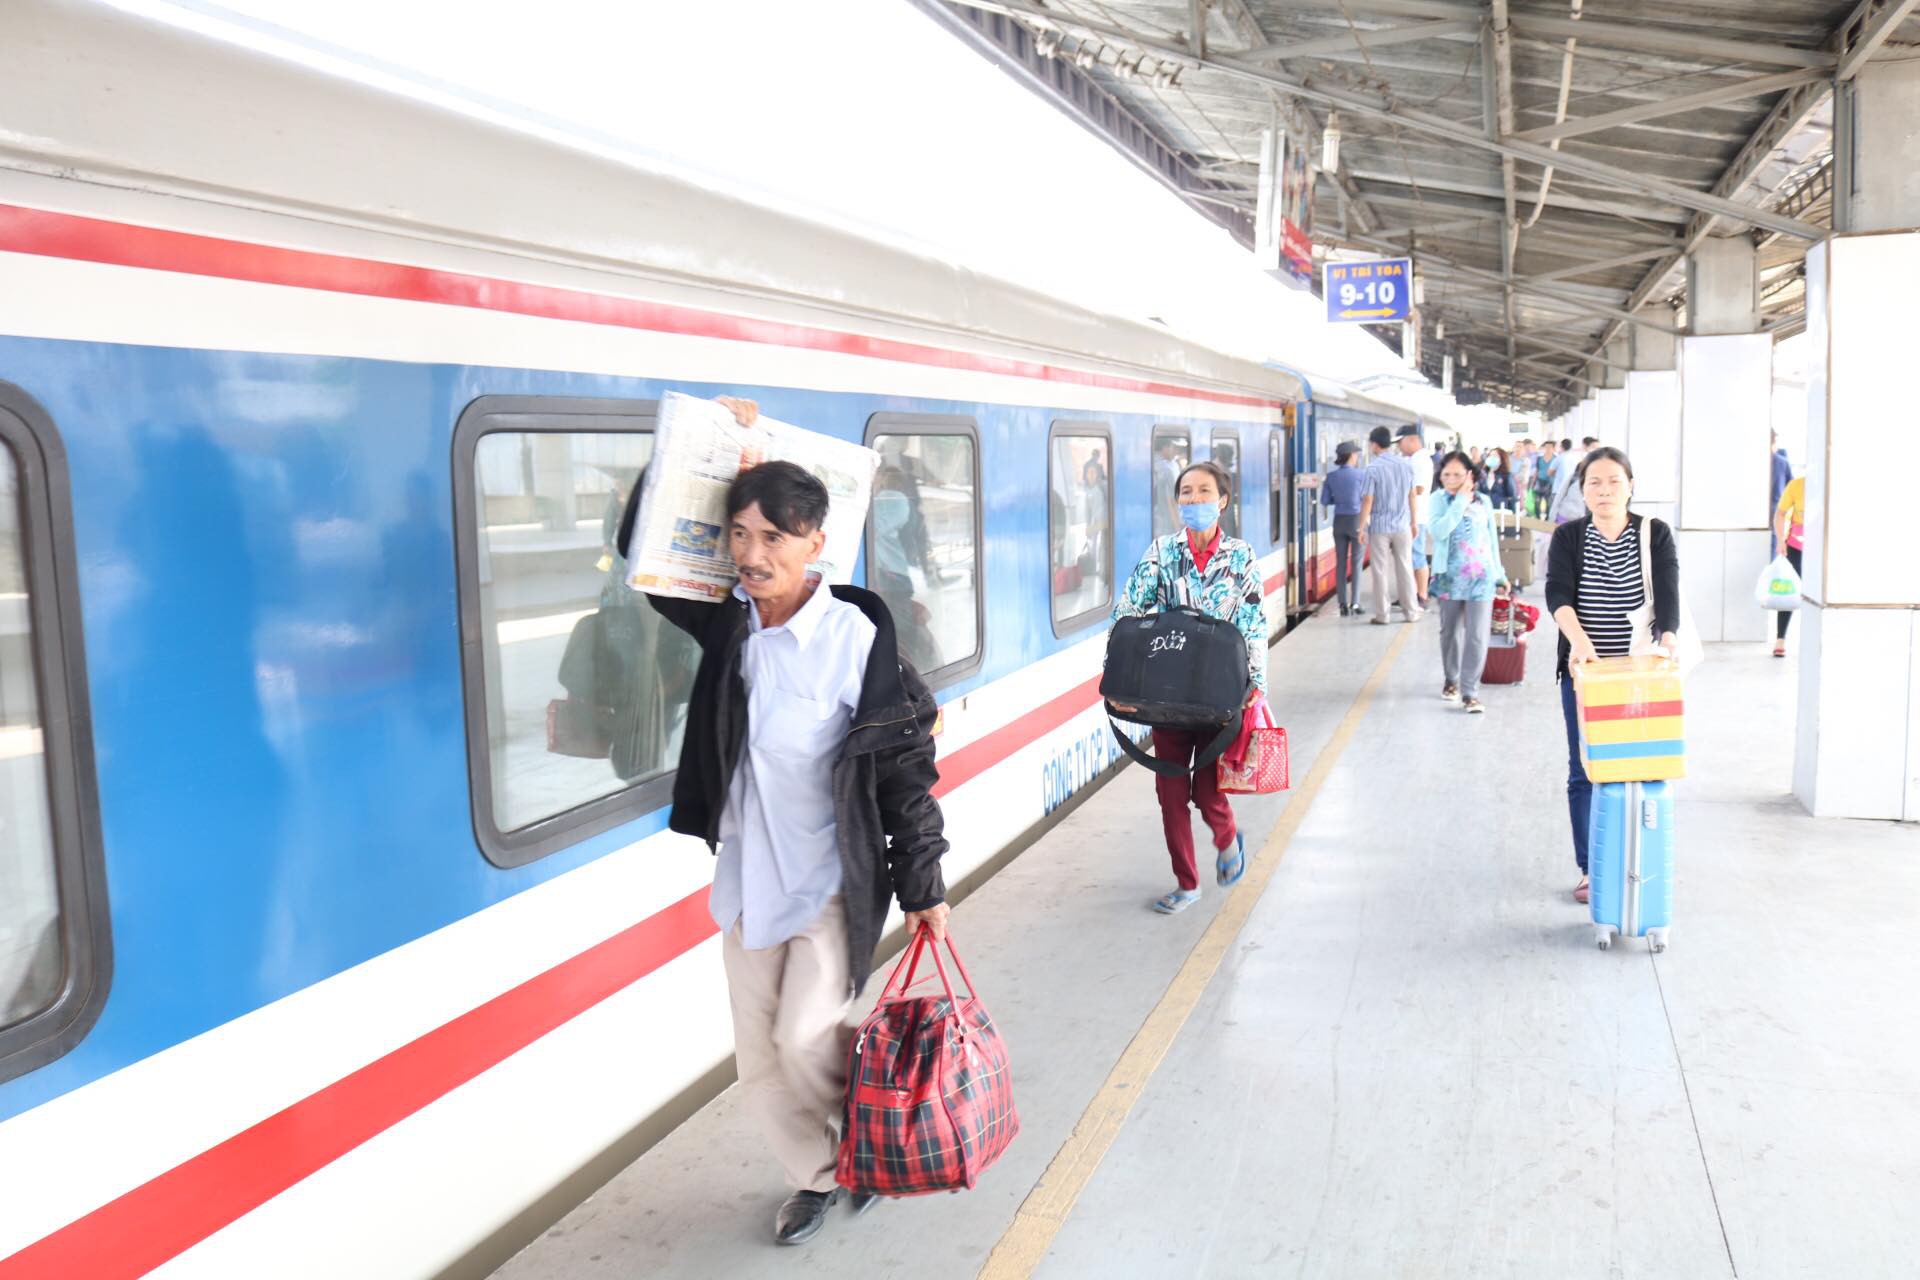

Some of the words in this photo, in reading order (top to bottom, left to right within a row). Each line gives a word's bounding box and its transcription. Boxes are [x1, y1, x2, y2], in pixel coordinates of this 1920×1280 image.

[1376, 264, 1402, 277] TOA
[1340, 281, 1395, 306] 9-10
[1075, 737, 1088, 791] TY
[1091, 727, 1103, 780] CP
